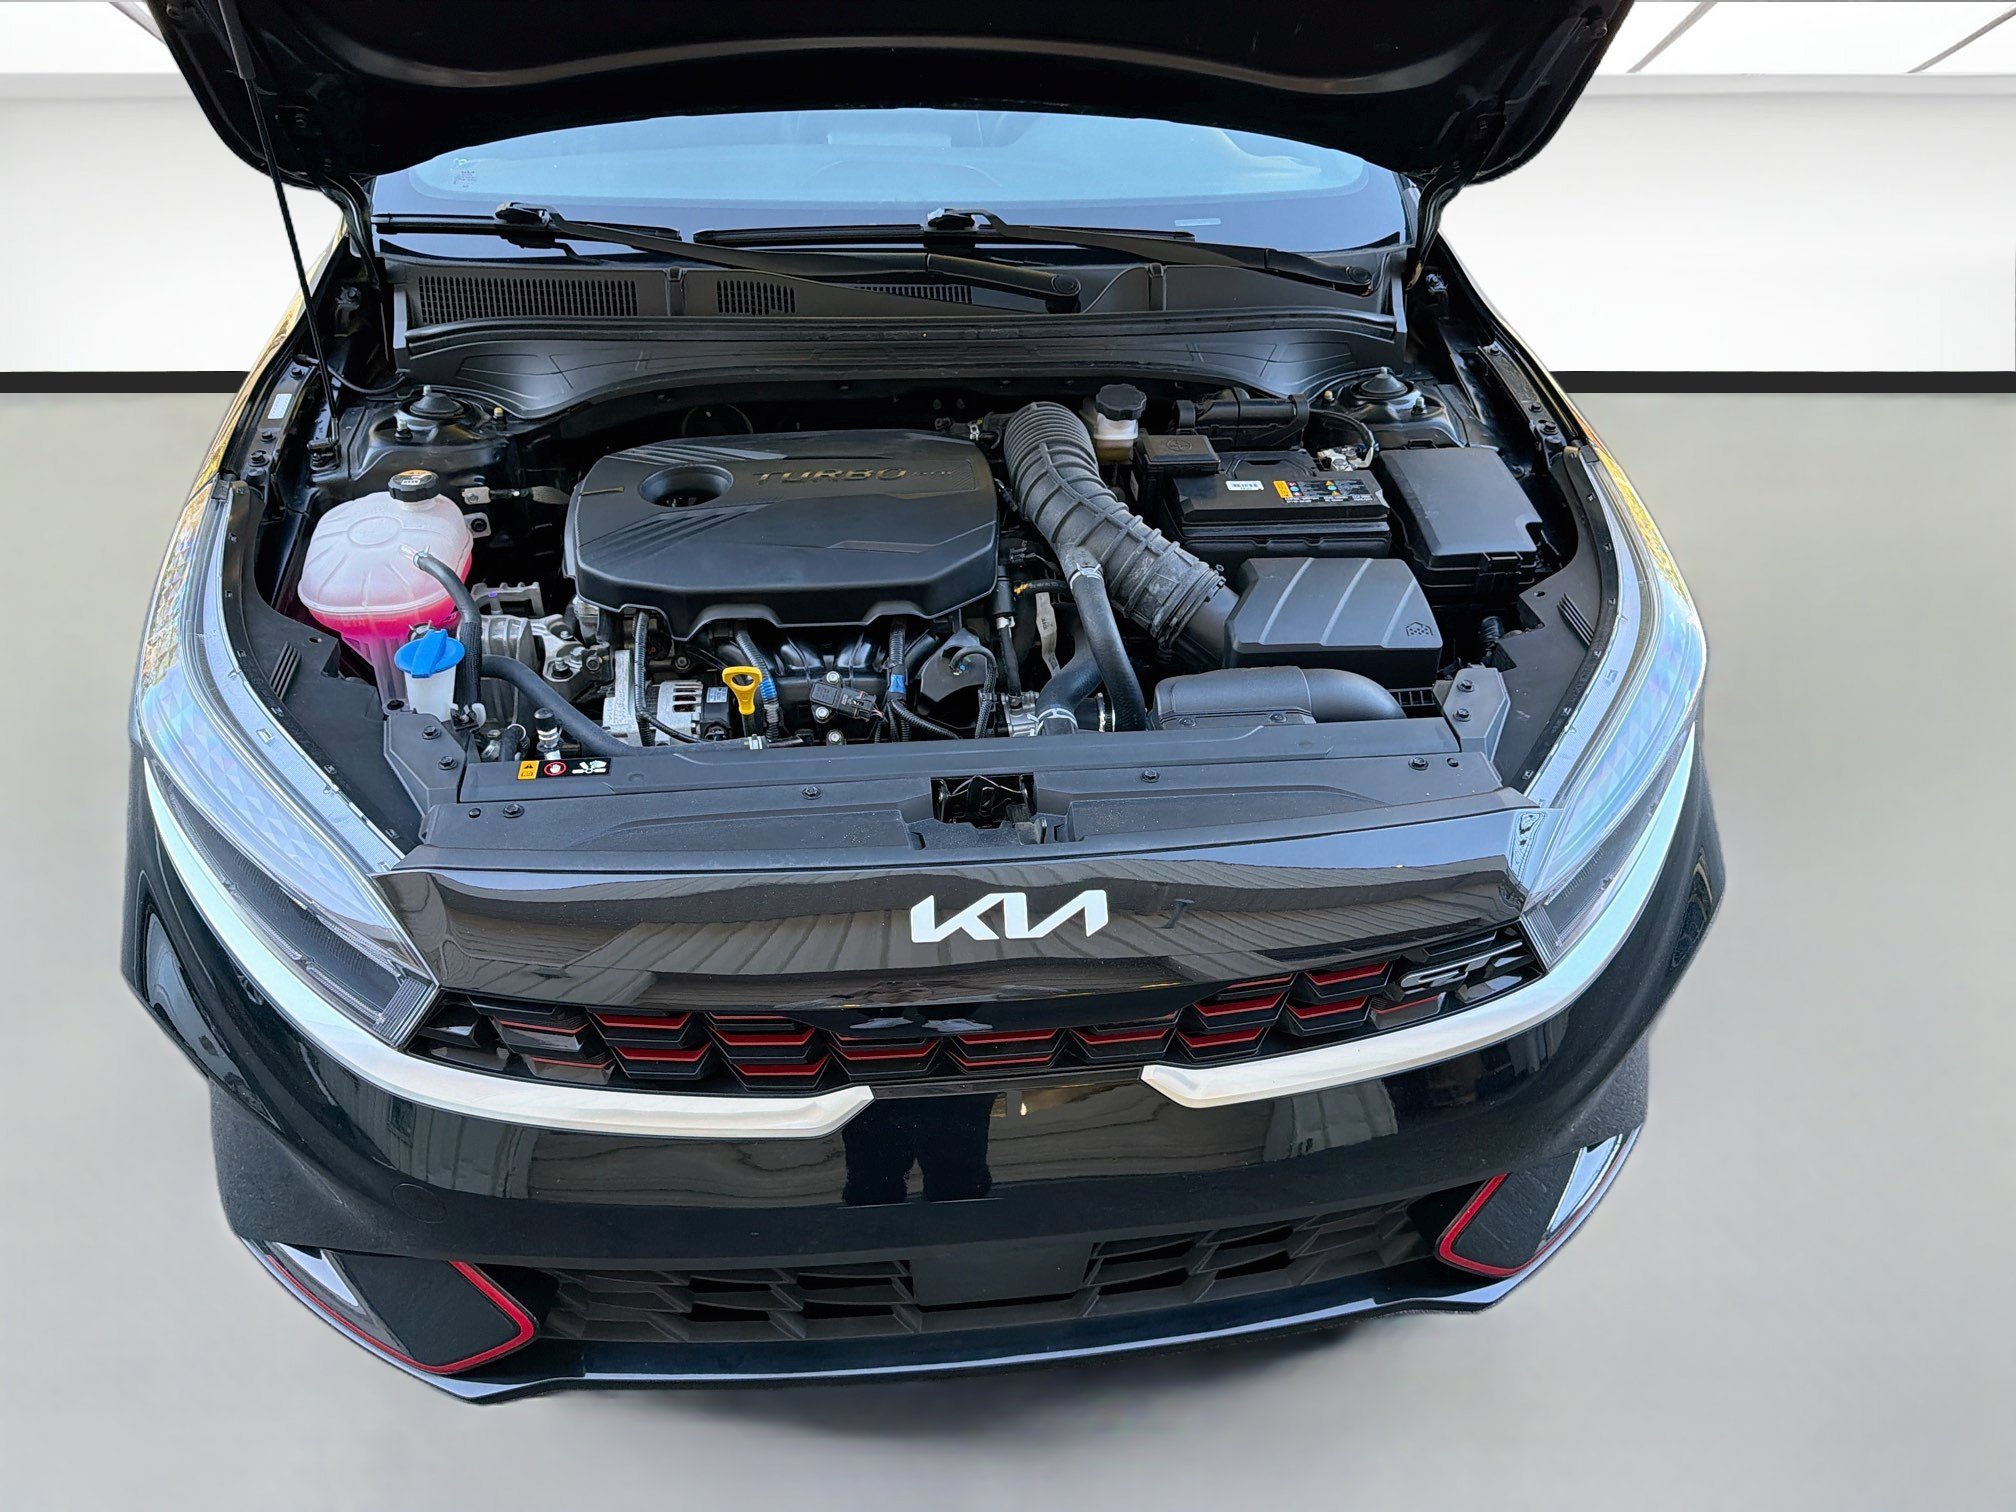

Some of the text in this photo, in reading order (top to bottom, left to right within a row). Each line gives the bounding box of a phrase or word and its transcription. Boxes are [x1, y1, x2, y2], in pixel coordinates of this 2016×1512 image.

[752, 467, 907, 486] TURBO
[910, 889, 1109, 943] KIA
[1400, 939, 1524, 995] GT
